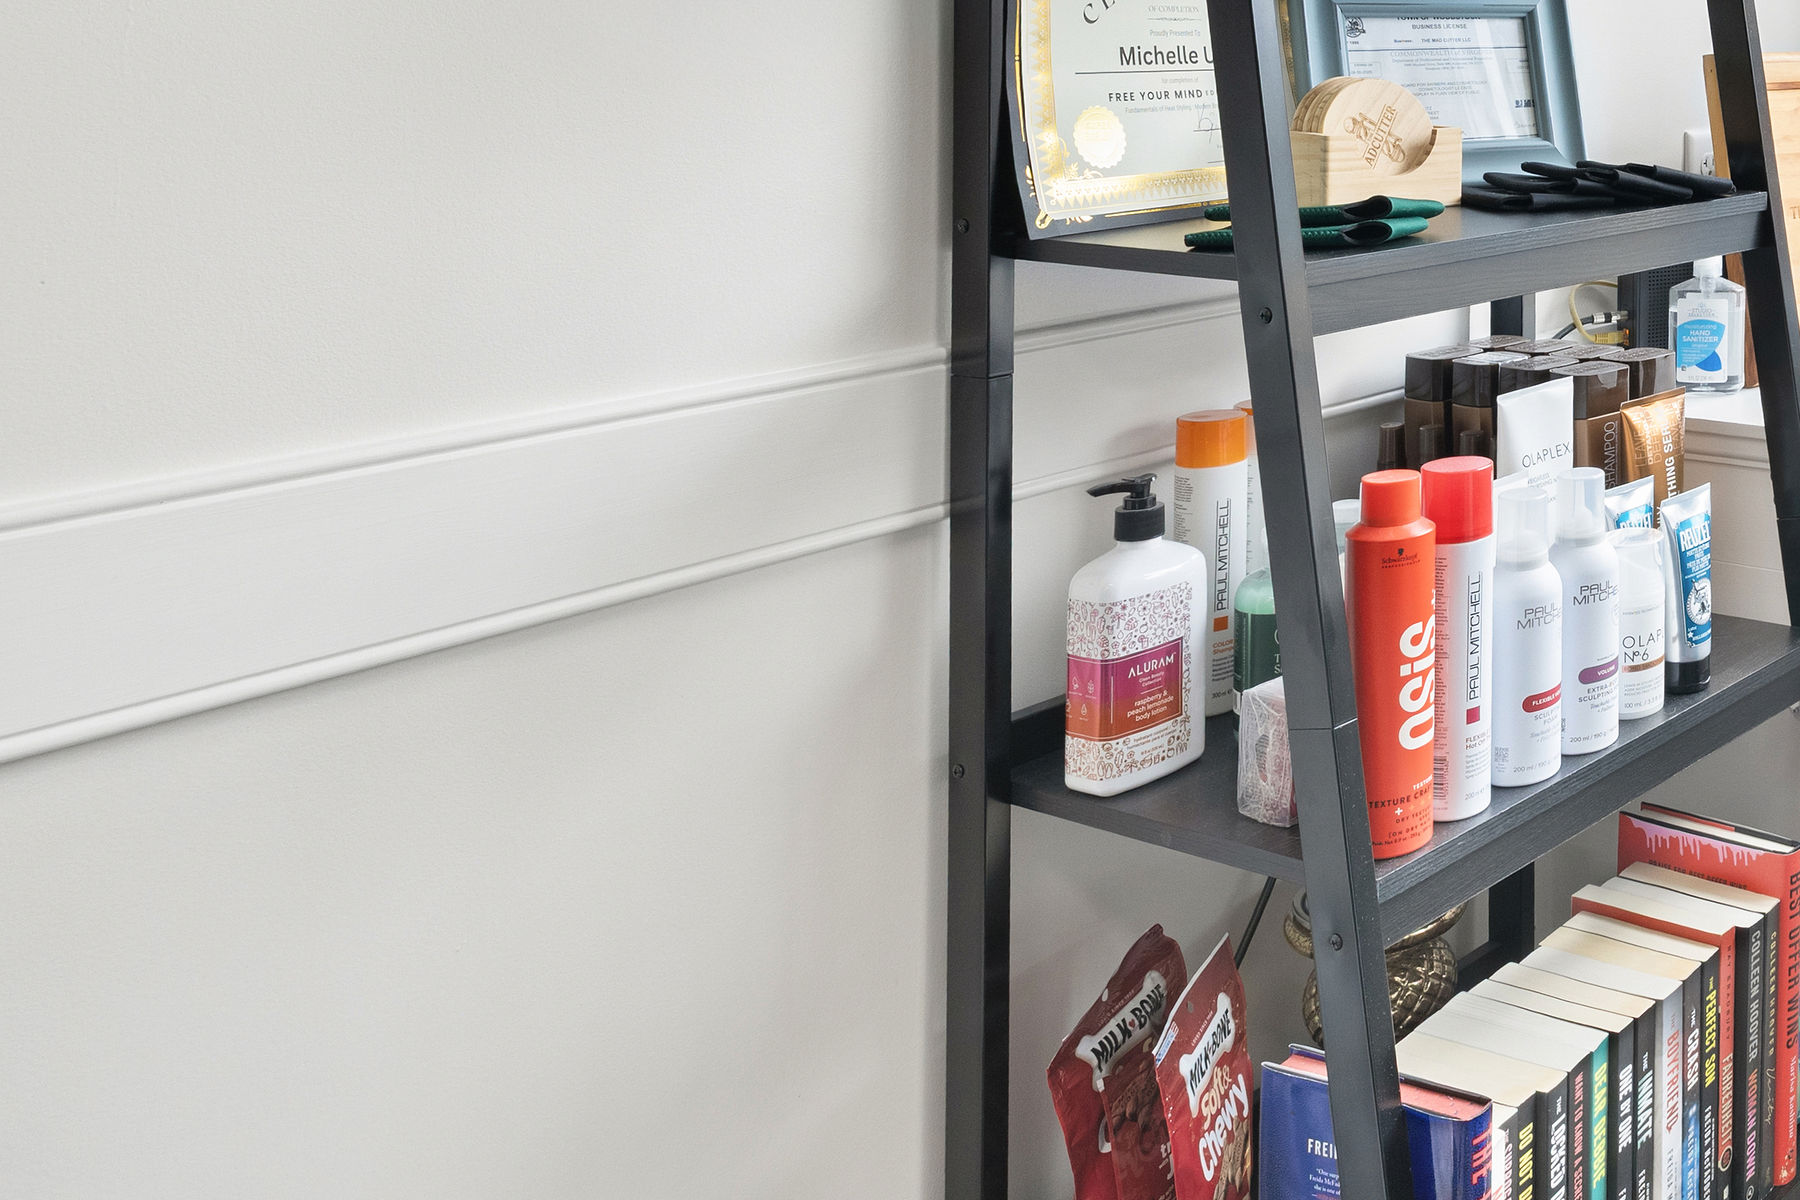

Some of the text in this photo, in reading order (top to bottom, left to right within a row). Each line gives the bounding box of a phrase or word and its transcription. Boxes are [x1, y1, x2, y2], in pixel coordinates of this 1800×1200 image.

[1119, 45, 1198, 66] Michelle
[1108, 91, 1135, 102] FREE
[1139, 90, 1170, 101] YOUR
[1174, 89, 1203, 99] MIND
[1364, 104, 1396, 167] ADCUTTER
[1682, 335, 1719, 343] SANITIZER
[1522, 441, 1572, 468] OLAPLEX
[1604, 421, 1616, 488] SHAMPOO
[1680, 519, 1711, 552] REUZEL
[1216, 503, 1231, 611] PAUL MITCHELL
[1580, 580, 1617, 596] PAUL
[1524, 602, 1560, 620] PAUL
[1468, 573, 1482, 701] PAUL MITCHELL
[1622, 628, 1663, 649] OLAP
[1127, 653, 1175, 679] ALURAM
[1597, 665, 1616, 676] VOLUME
[1126, 694, 1175, 718] peach lemonade
[1134, 693, 1162, 707] raspberry
[1212, 691, 1222, 699] 300
[1532, 693, 1555, 706] FLEXIBLE
[1135, 705, 1168, 722] body lotion
[1465, 742, 1476, 750] Hot
[1582, 734, 1590, 742] ml
[1369, 794, 1411, 808] TEXTURE
[1464, 792, 1476, 800] 200
[1787, 924, 1800, 990] OFFER
[1768, 931, 1778, 1057] COLLEEN HOOVER
[1705, 989, 1717, 1054] PERFECT
[1786, 993, 1799, 1050] WINS
[1686, 1028, 1699, 1091] CRASH
[1704, 1053, 1716, 1088] SON
[1745, 929, 1761, 1182] COLLEEN HOOVER WOMAN DOWN
[1665, 1029, 1681, 1135] BOYFRIEND
[1789, 1055, 1797, 1094] Marisa
[1618, 1063, 1632, 1153] ONE BY ONE
[1637, 1070, 1653, 1150] INMATE
[1721, 1052, 1734, 1146] FAHRENHEIT
[1764, 1066, 1776, 1126] Verity
[1199, 1073, 1249, 1182] Chewy
[1519, 1121, 1534, 1151] DO
[1573, 1071, 1583, 1200] WANT TO KNOW A SECRE
[1593, 1062, 1607, 1189] DEAR DEBBIE
[1704, 1105, 1712, 1147] FREIDA
[1307, 1138, 1337, 1160] FREI
[1471, 1125, 1492, 1185] THE
[1551, 1113, 1566, 1189] LOCKED
[1309, 1174, 1323, 1184] Freida
[1518, 1151, 1533, 1186] NOT
[1666, 1148, 1674, 1189] FREIDA
[1313, 1183, 1322, 1191] she
